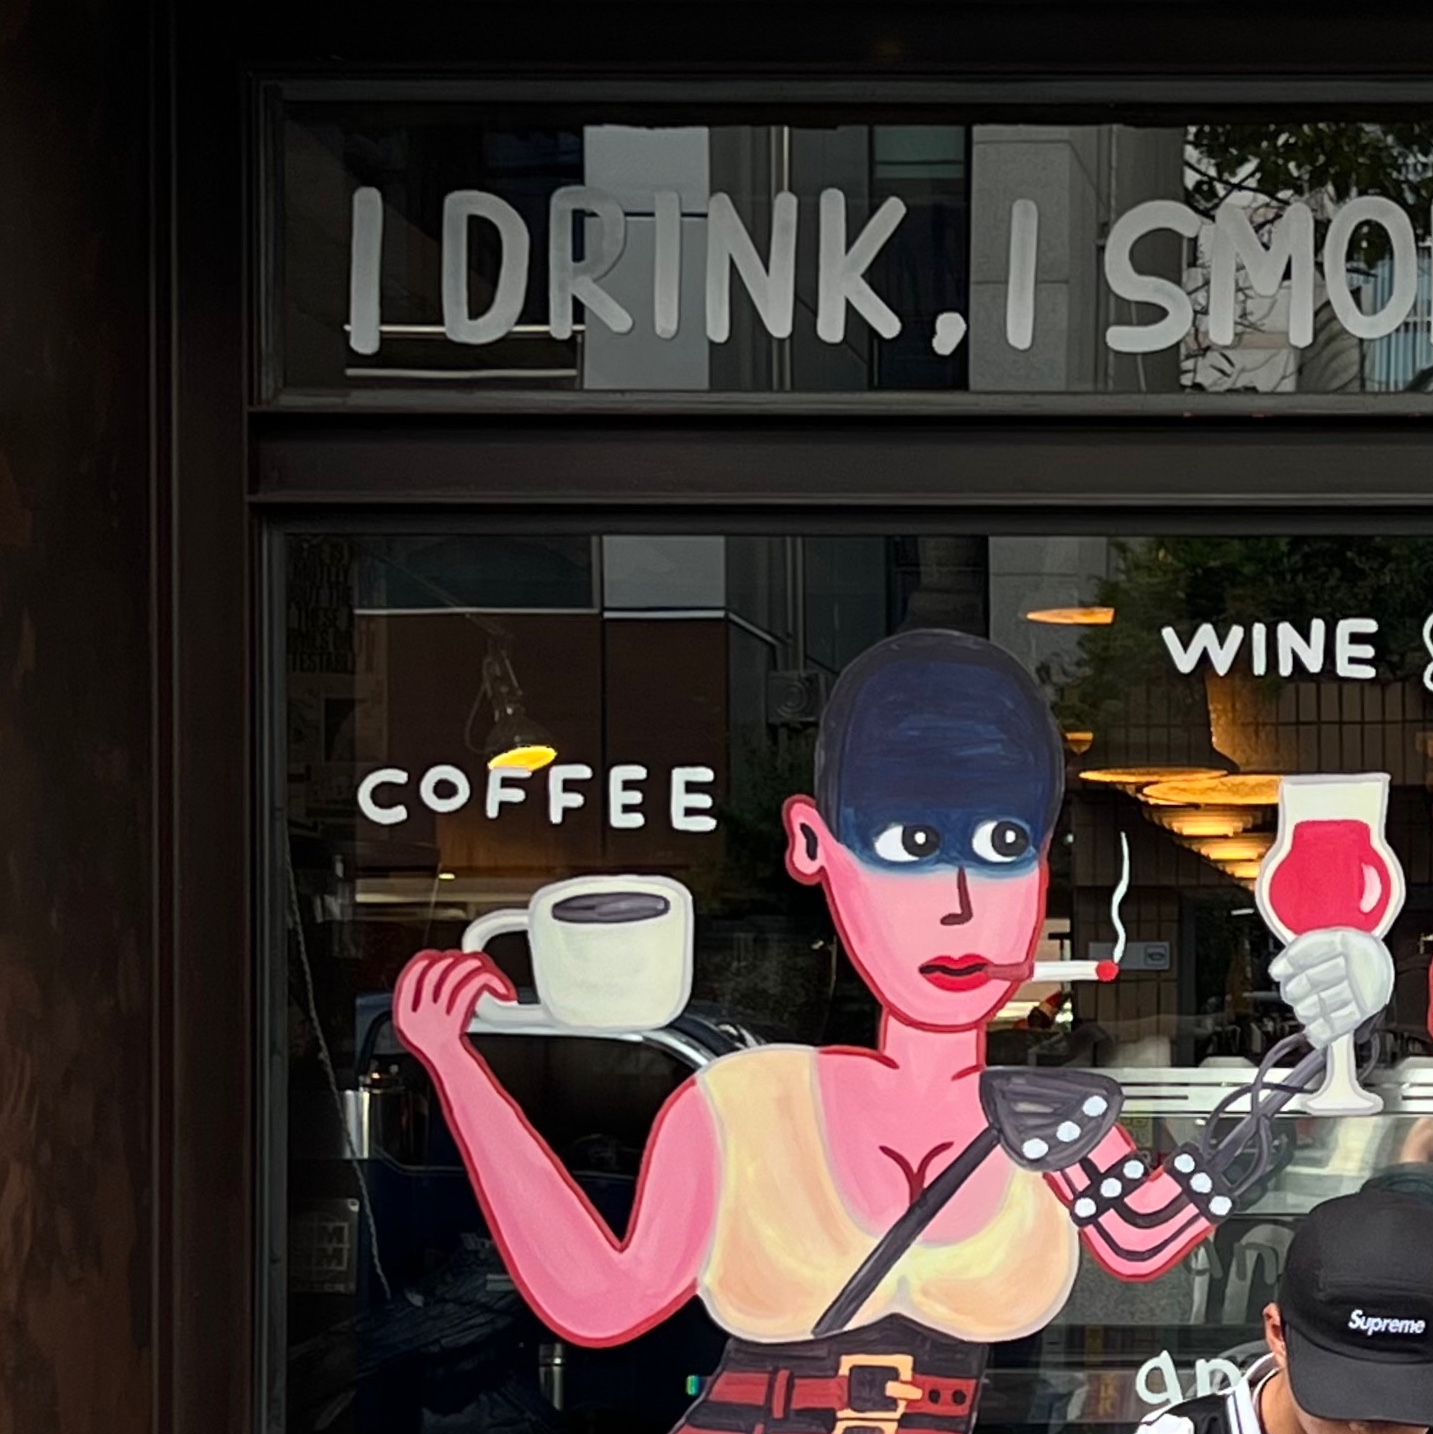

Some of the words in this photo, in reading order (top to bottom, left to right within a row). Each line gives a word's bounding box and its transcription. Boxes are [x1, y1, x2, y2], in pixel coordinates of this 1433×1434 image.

[349, 186, 383, 354] I
[442, 186, 966, 355] DRINK,
[1006, 199, 1038, 350] I
[1161, 617, 1380, 679] WINE
[357, 763, 718, 833] COFFEE
[1347, 1309, 1426, 1336] Supreme
[1136, 1350, 1246, 1405] an
